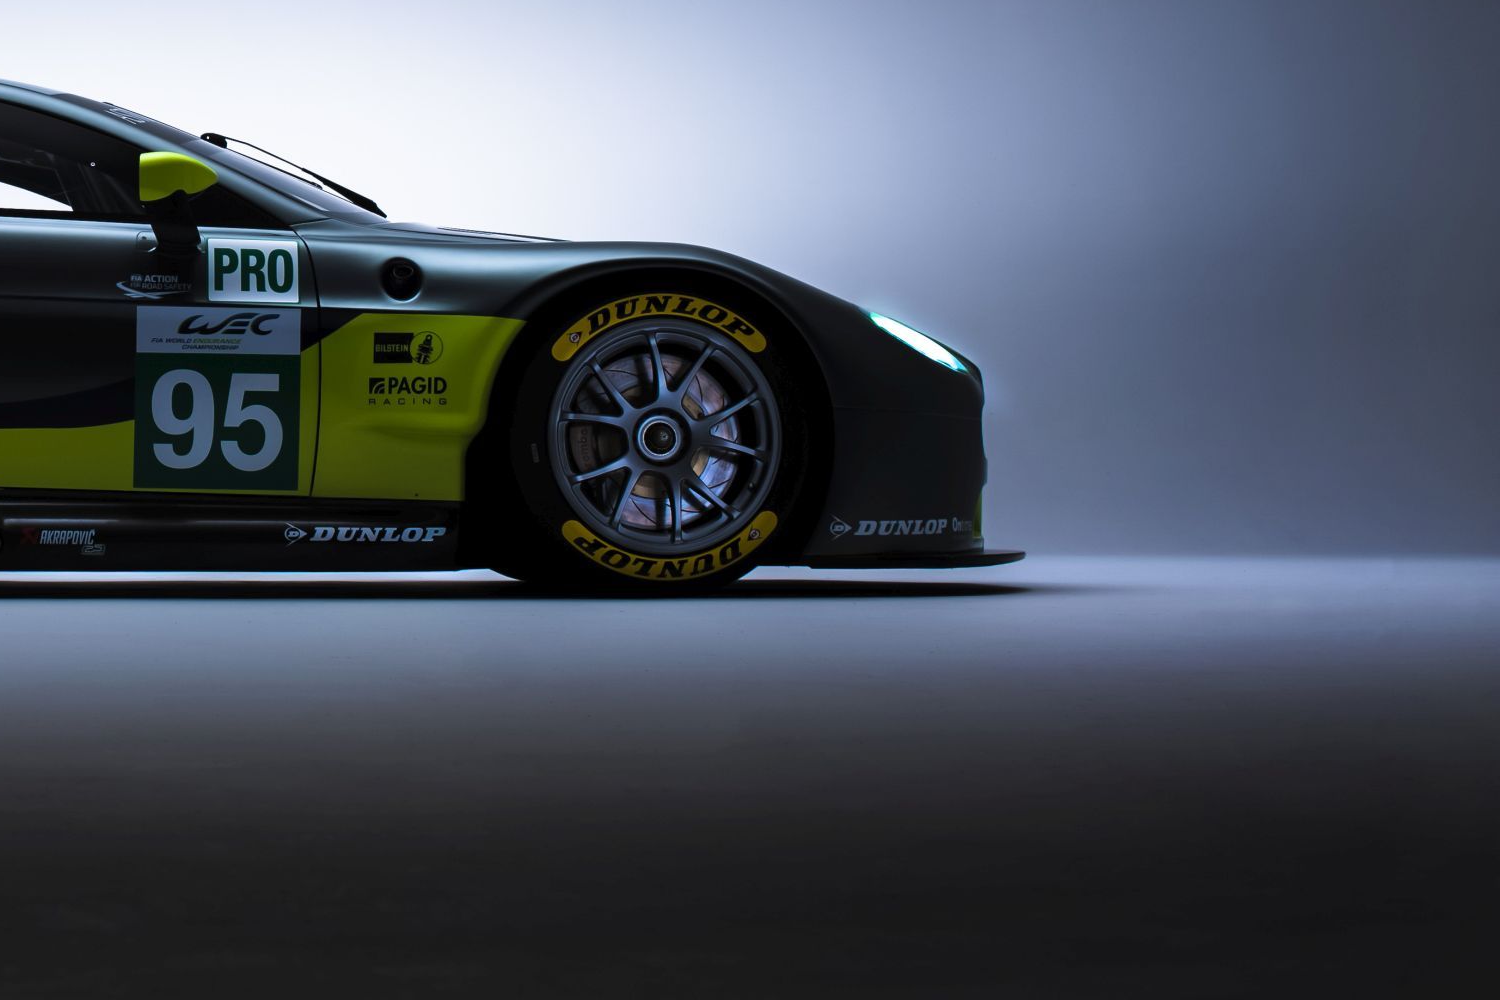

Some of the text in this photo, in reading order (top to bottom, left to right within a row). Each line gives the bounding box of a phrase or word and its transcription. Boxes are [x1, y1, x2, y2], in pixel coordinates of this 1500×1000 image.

[144, 275, 178, 283] ACTION
[214, 248, 294, 293] PRO
[178, 312, 280, 335] WEC
[588, 295, 755, 337] DUNLOP
[375, 343, 410, 353] BILSTEIN
[388, 376, 447, 394] PAGID
[368, 397, 448, 405] RACING
[151, 368, 284, 472] 95
[309, 526, 447, 542] DUNLOP
[854, 519, 948, 535] DUNLOP
[574, 537, 742, 577] DUNLOP
